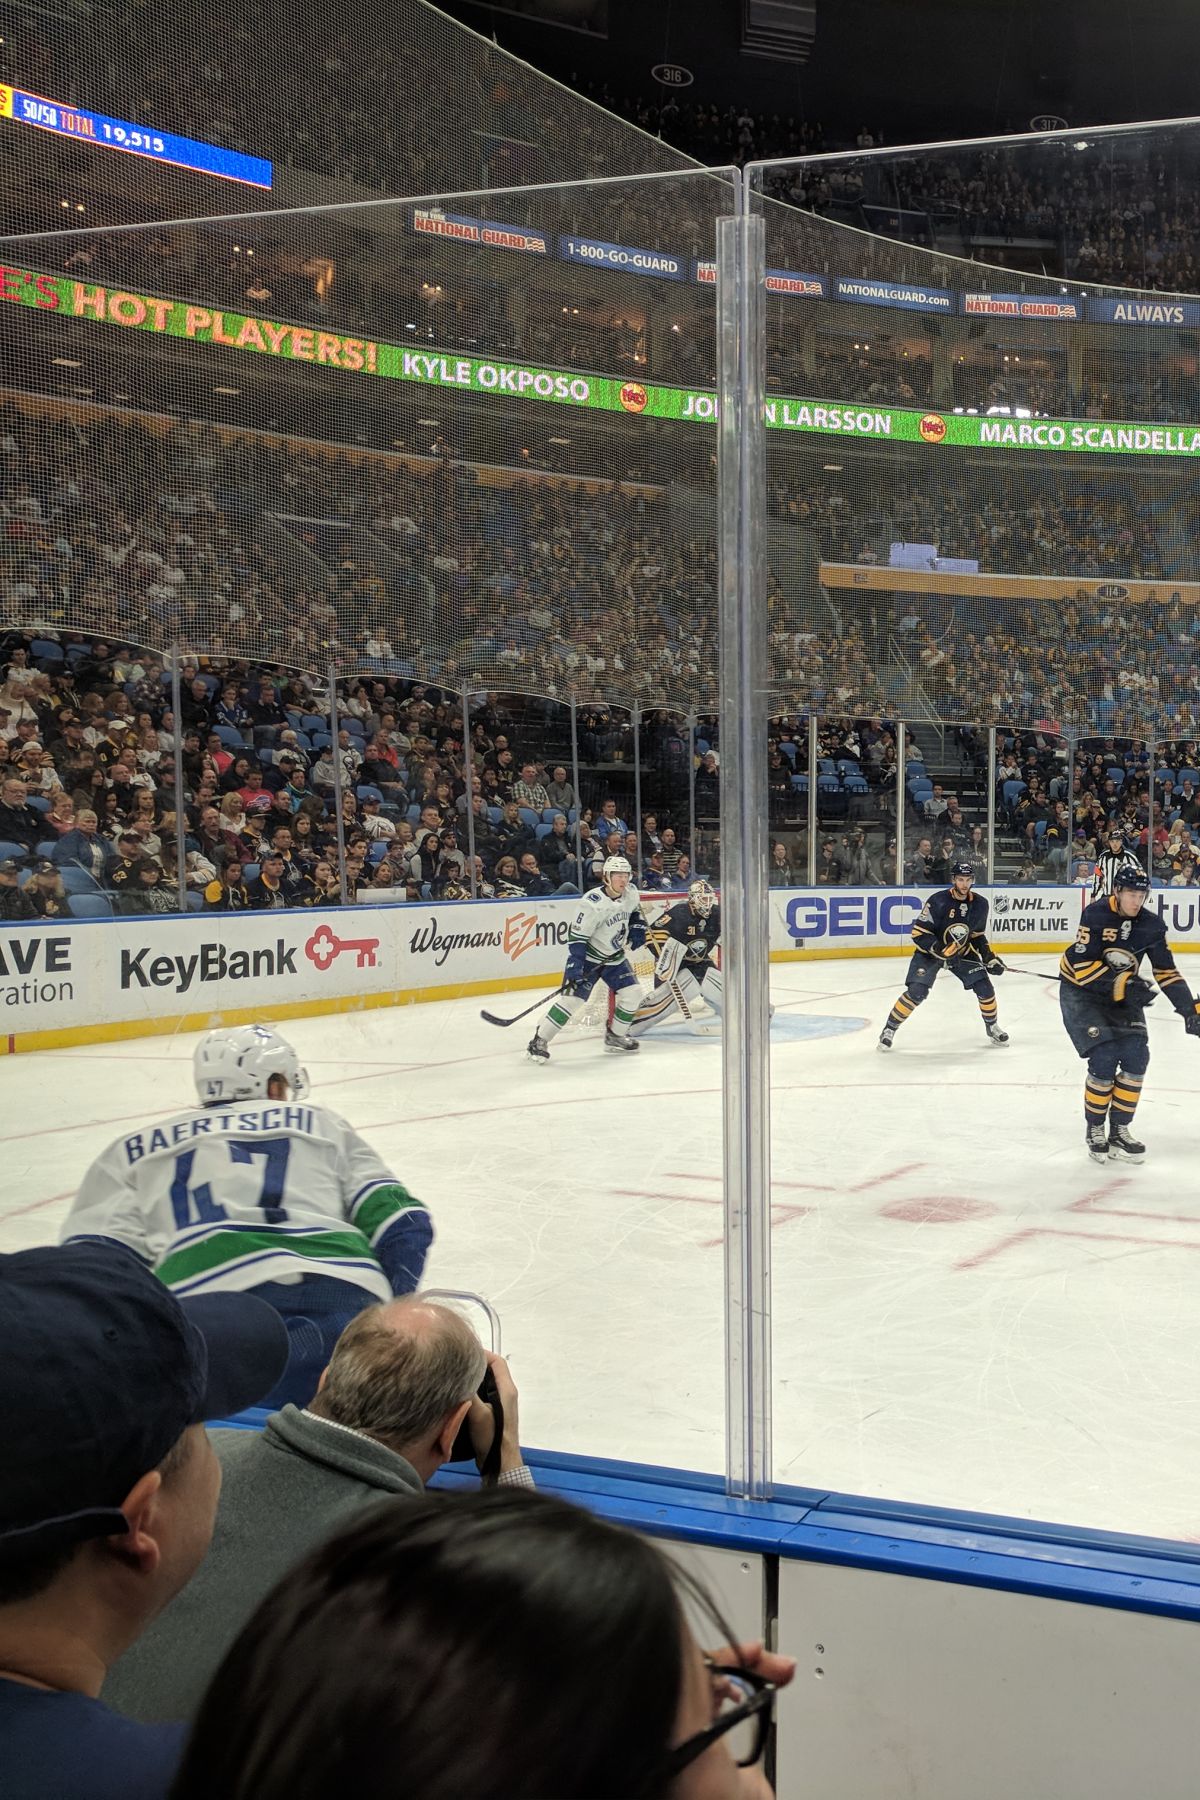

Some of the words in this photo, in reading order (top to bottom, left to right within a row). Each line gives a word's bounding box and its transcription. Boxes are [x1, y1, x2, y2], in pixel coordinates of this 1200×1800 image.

[663, 68, 682, 82] 316
[22, 98, 57, 127] 50/50
[60, 110, 96, 137] TOTAL
[103, 123, 164, 152] 19,515
[414, 217, 480, 241] NATIONAL
[481, 228, 528, 250] GUARD
[566, 242, 678, 273] 1-800-GO-GUARD
[765, 275, 805, 294] GUARD
[838, 282, 949, 307] NATIONALGUARD.com
[965, 300, 1020, 315] NATIONAL
[1021, 303, 1060, 317] GUARD
[1113, 303, 1184, 323] ALWAYS
[73, 282, 174, 332] HOT
[185, 305, 378, 372] PLAYERS!
[403, 352, 472, 385] KYLE
[477, 365, 590, 402] OKPOSO
[682, 395, 777, 425] JON
[782, 402, 892, 434] LARSSON
[980, 422, 1065, 447] MARCO
[786, 895, 923, 938] GEIC
[949, 908, 956, 919] 6
[1011, 897, 1064, 911] NHL.TV
[576, 911, 585, 924] 6
[1040, 917, 1069, 931] LIVE
[408, 916, 503, 967] Wegmans
[686, 926, 696, 936] 31
[1102, 927, 1119, 943] 55
[120, 938, 298, 994] KeyBank
[207, 1080, 224, 1097] 47
[125, 1106, 314, 1165] BAERTSCHI
[170, 1137, 291, 1233] 47
